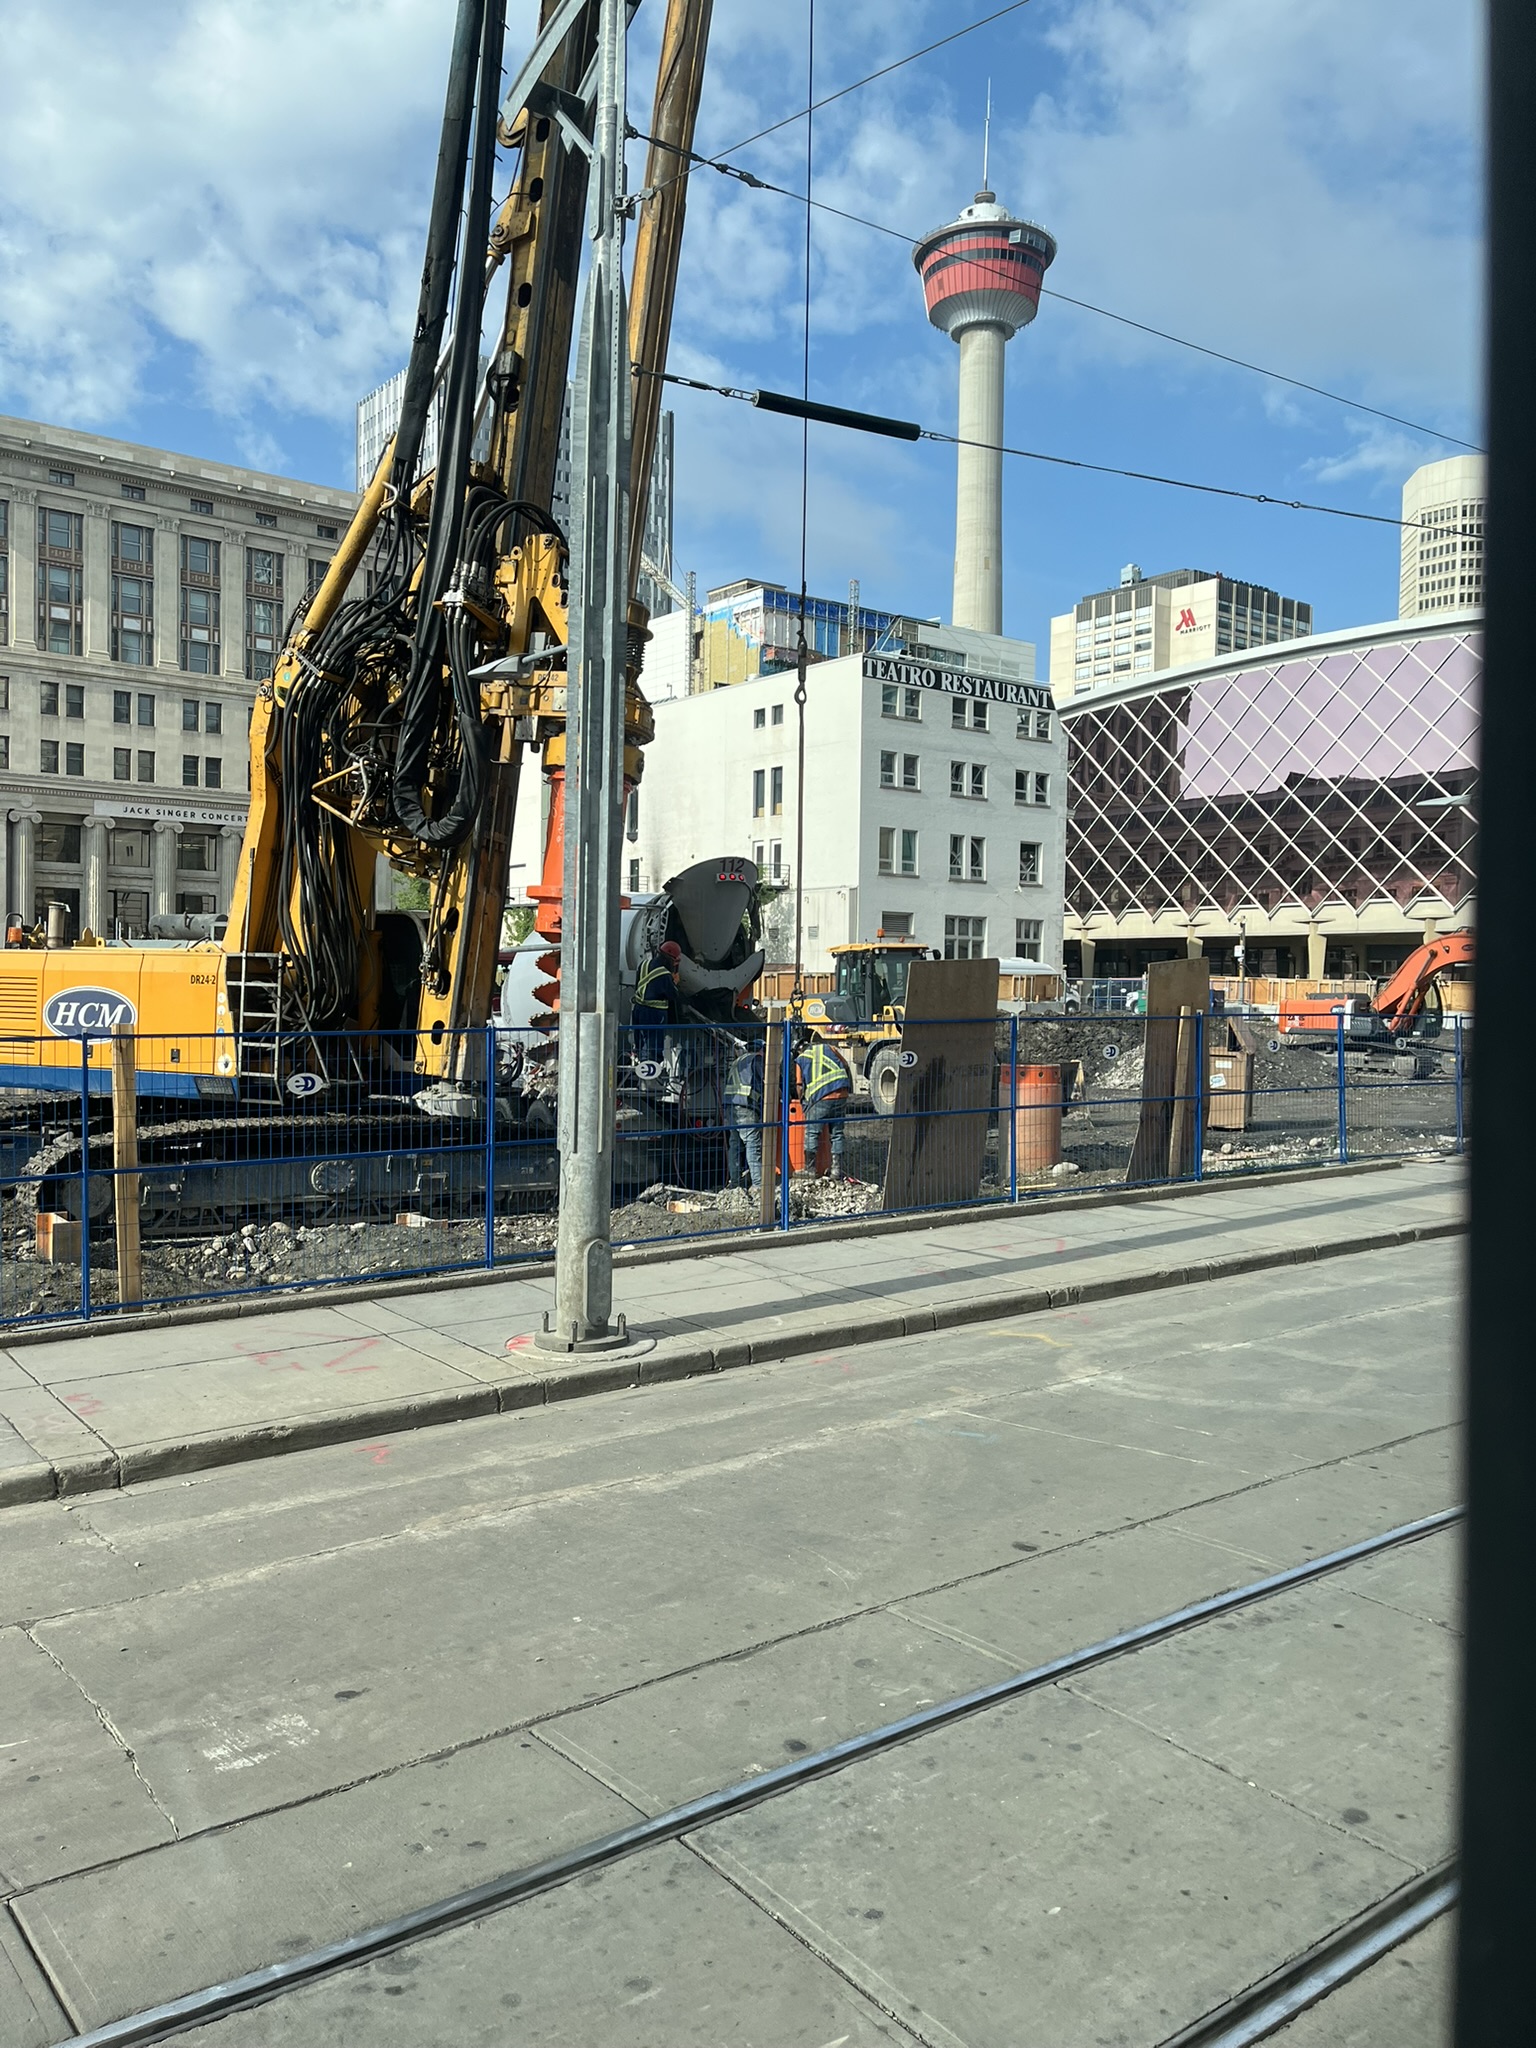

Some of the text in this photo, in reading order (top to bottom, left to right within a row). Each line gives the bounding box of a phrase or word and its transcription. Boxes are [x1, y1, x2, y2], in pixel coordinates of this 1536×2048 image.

[1180, 623, 1211, 635] MARRIOTT
[863, 657, 1051, 709] TEATRO RESTAURANT
[123, 806, 249, 823] JACK SINGER CONCERT
[720, 858, 745, 872] 112
[190, 974, 216, 985] DR24-2
[53, 1002, 126, 1028] HCM
